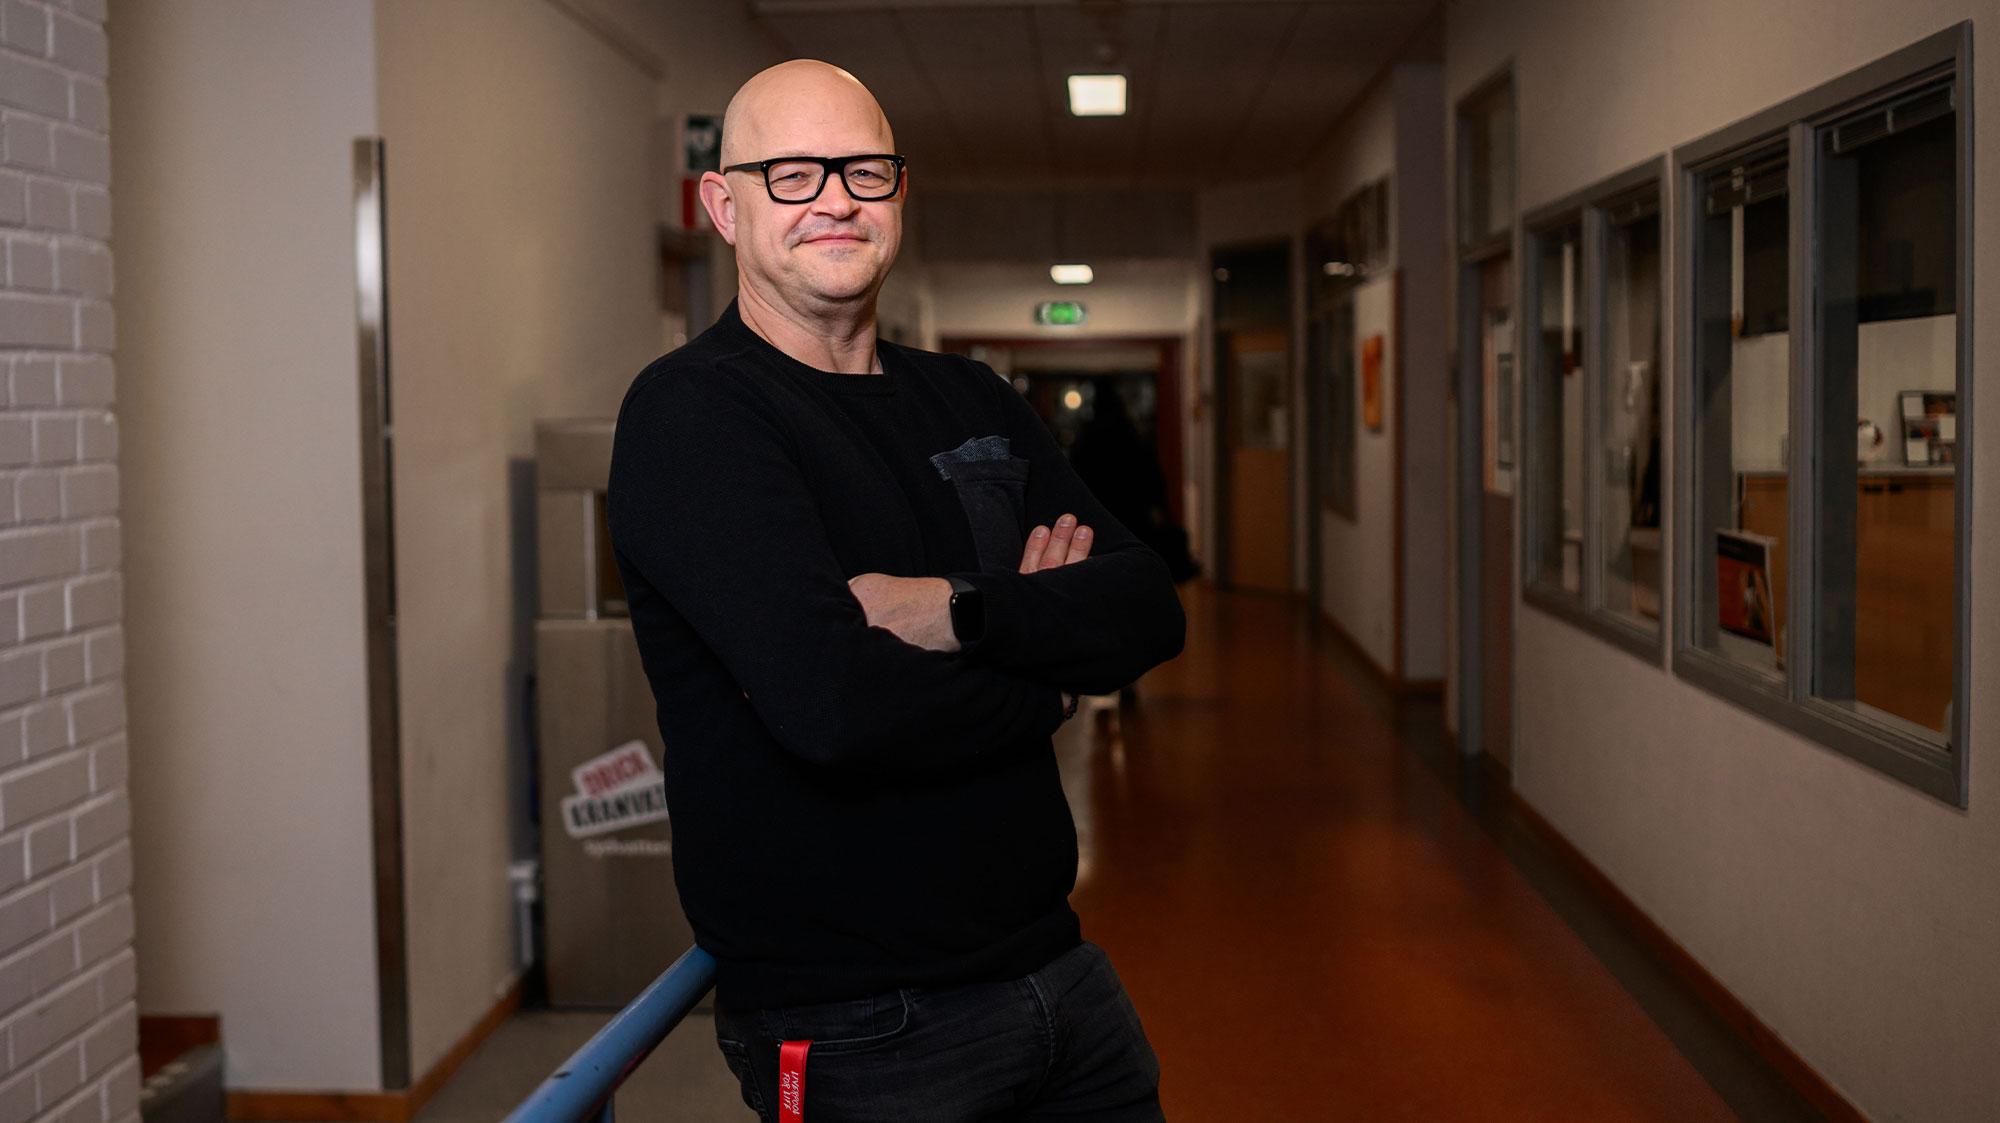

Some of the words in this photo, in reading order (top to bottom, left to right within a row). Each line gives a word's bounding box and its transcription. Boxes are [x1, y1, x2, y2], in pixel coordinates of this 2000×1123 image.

[583, 752, 646, 796] DRICK
[782, 1072, 791, 1090] FOR
[791, 1070, 800, 1115] LIVERPOOL
[783, 1090, 791, 1110] LIFE
